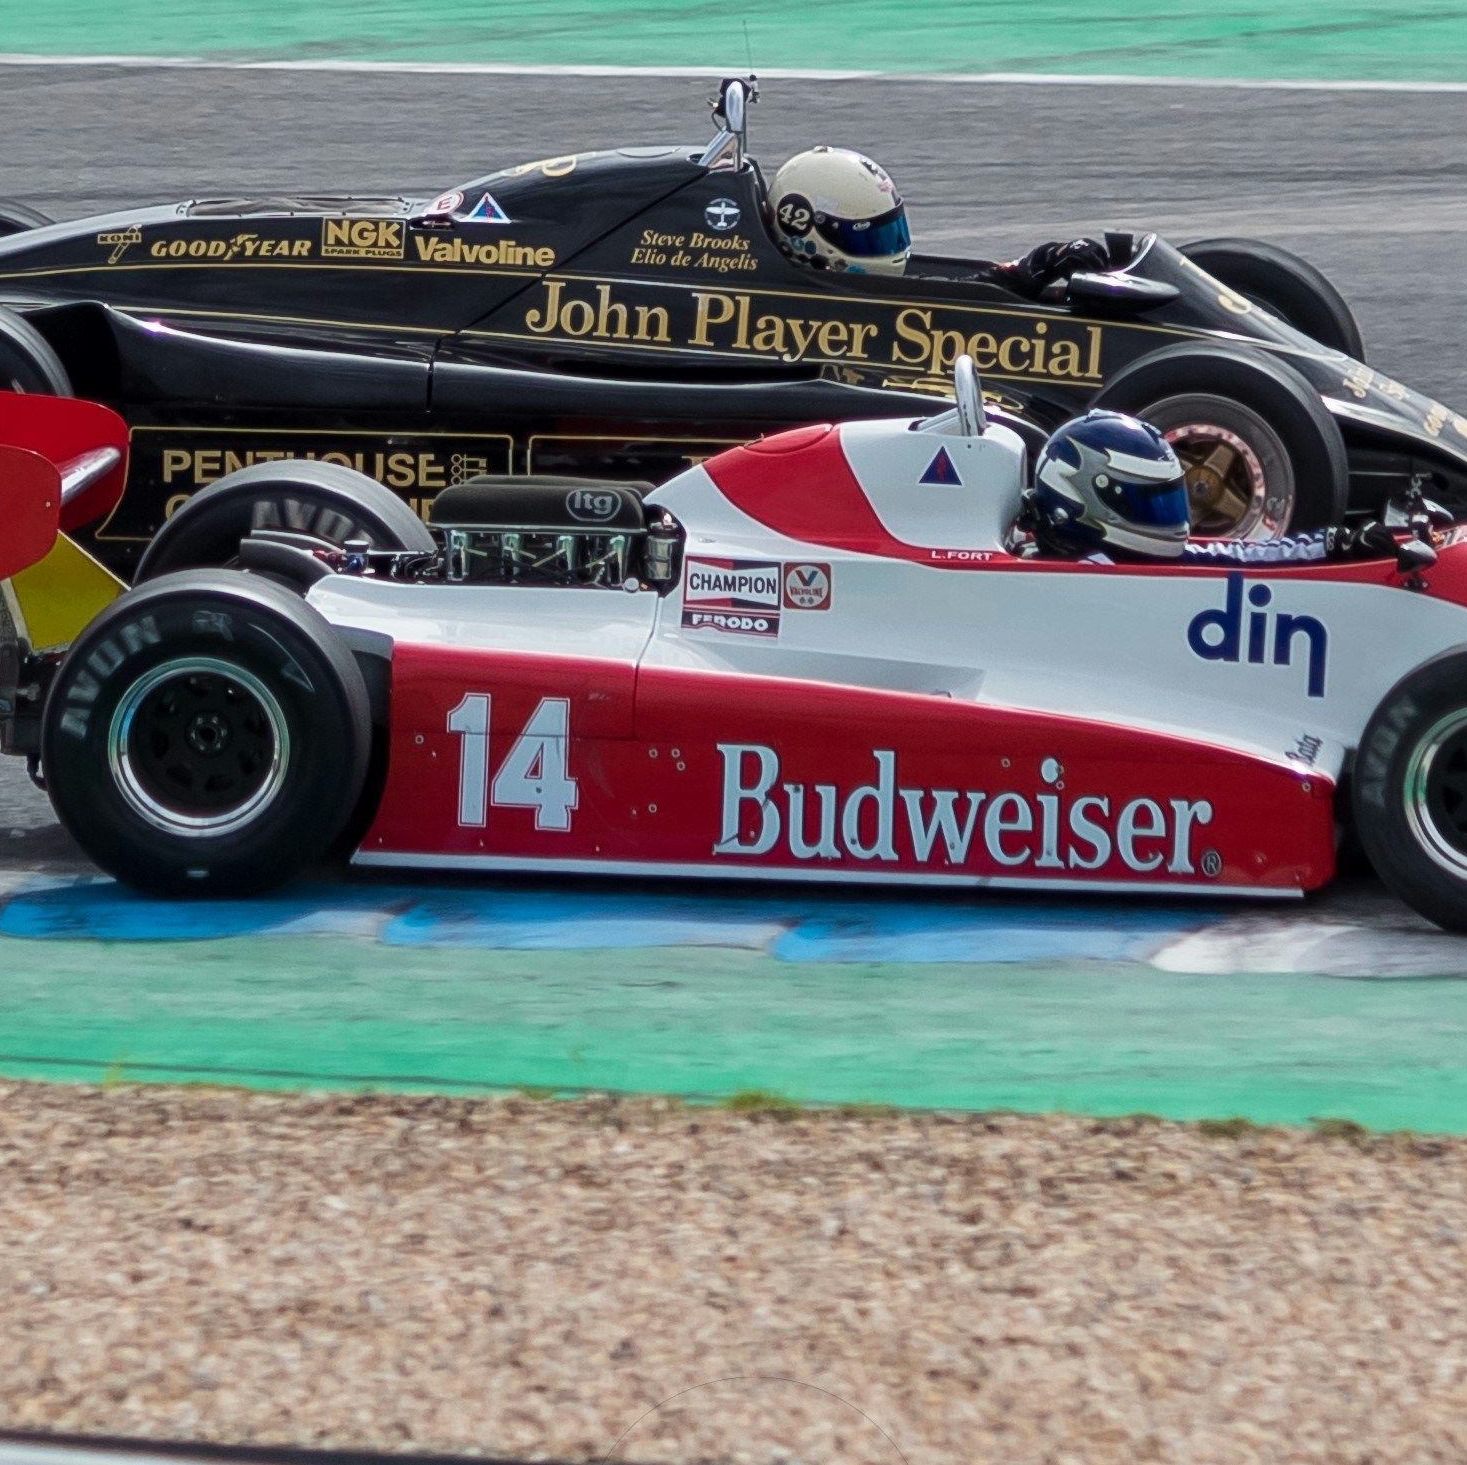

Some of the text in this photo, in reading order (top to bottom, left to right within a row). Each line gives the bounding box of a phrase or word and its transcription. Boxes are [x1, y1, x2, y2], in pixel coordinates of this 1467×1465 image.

[100, 234, 141, 243] KONI
[150, 234, 312, 260] GOODYEAR
[327, 220, 400, 247] NGK
[640, 229, 750, 251] Steve Brooks
[415, 235, 555, 267] Valvoline
[630, 247, 758, 273] Elio de Angelis
[525, 280, 1103, 379] John Player Special
[162, 449, 446, 487] PENUSE
[689, 572, 777, 595] CHAMPION
[1188, 573, 1327, 698] din
[447, 692, 578, 832] 14
[713, 743, 1212, 874] Budweiser
